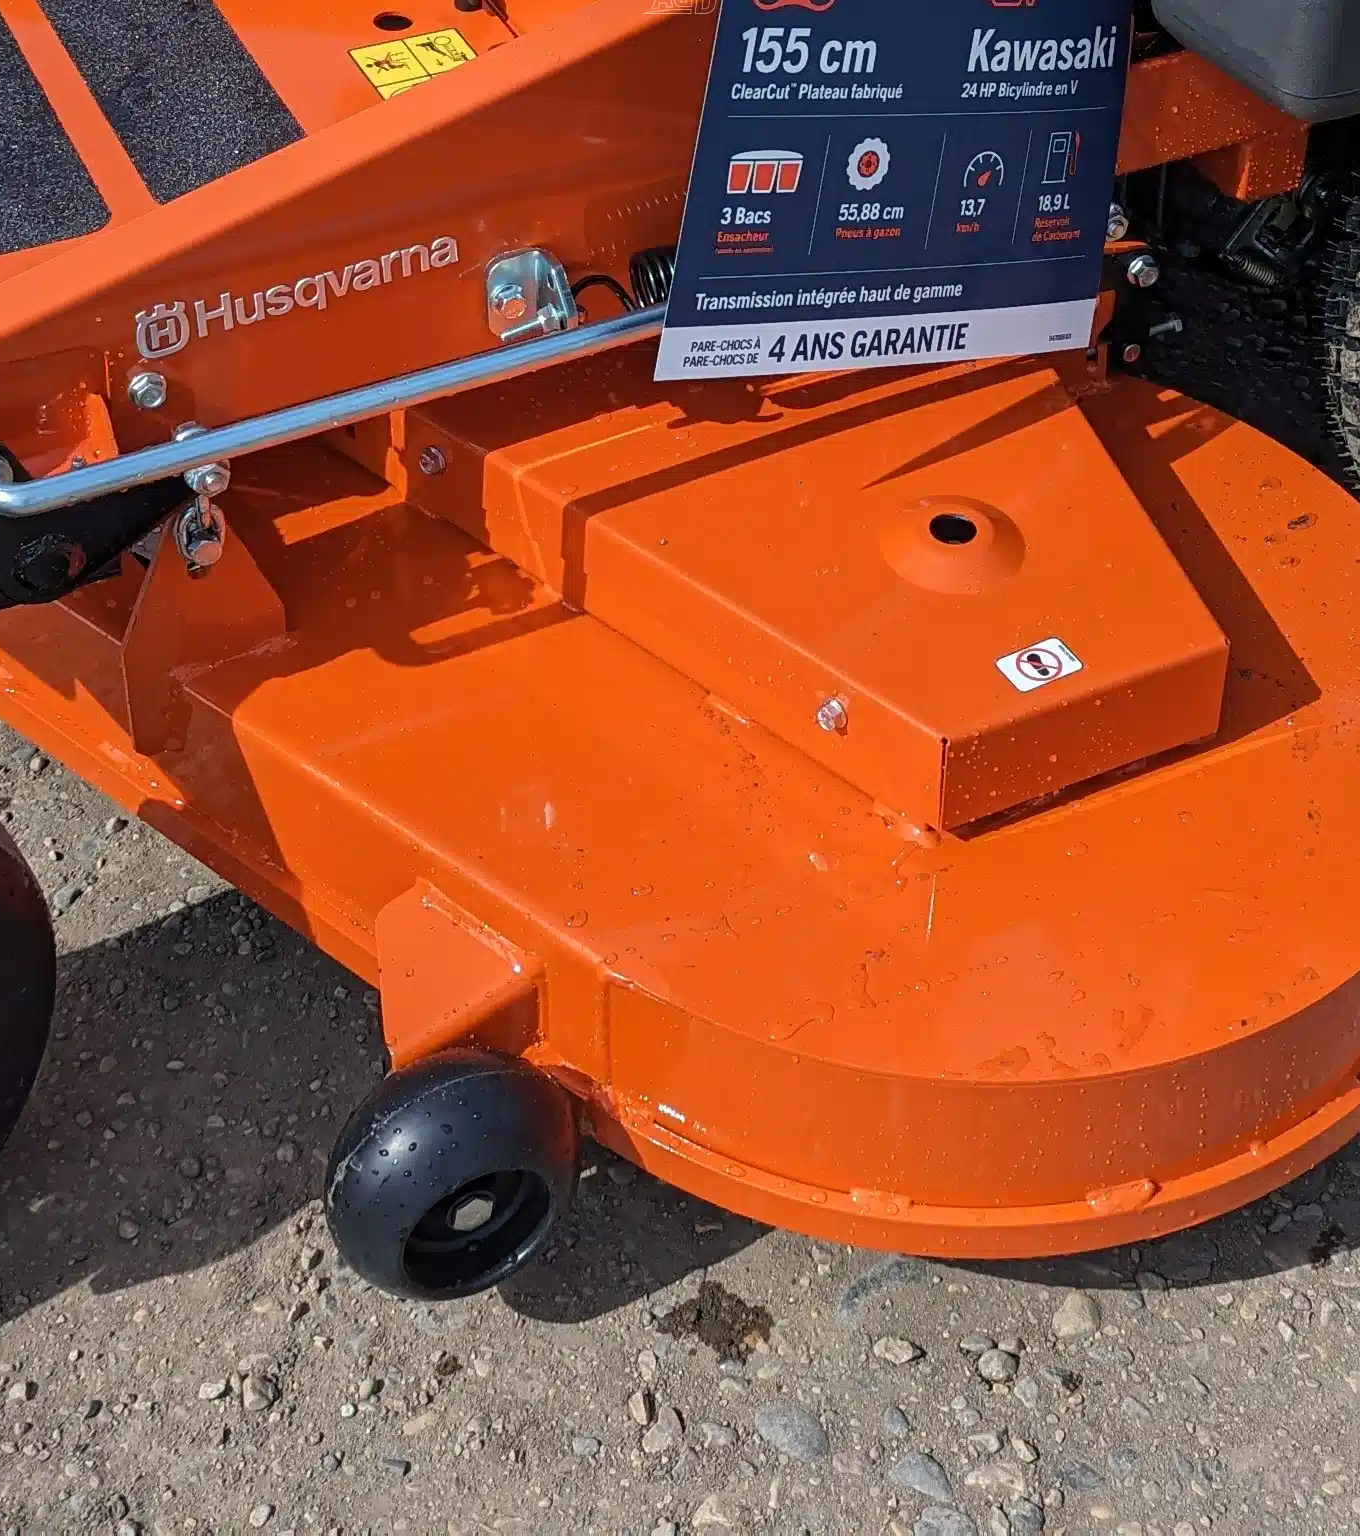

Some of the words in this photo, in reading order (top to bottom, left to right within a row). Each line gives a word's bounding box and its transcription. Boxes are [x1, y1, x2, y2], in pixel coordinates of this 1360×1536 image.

[741, 27, 810, 74] 155
[820, 37, 877, 74] cm
[967, 26, 1117, 73] Kawasaki
[799, 84, 848, 100] Plateau
[850, 83, 903, 102] fabriqué
[961, 82, 978, 98] 24
[980, 82, 998, 98] HP
[998, 81, 1053, 98] Bicylindre
[1055, 83, 1068, 95] en
[1070, 80, 1079, 95] V
[960, 198, 986, 217] 13,7
[1038, 194, 1062, 212] 18,9
[1064, 193, 1070, 210] L
[720, 207, 731, 225] 3
[735, 207, 771, 224] Bacs
[838, 203, 880, 223] 55,88
[883, 204, 904, 220] cm
[717, 230, 769, 243] Ensacheur
[194, 234, 461, 339] Husqvarna
[695, 289, 792, 311] Transmission
[797, 287, 857, 311] intégrée
[859, 285, 890, 303] haut
[894, 284, 910, 301] de
[913, 284, 962, 304] gamme
[690, 338, 752, 353] PARE-CHOCS
[753, 335, 761, 350] À
[768, 334, 786, 363] 4
[791, 332, 845, 362] ANS
[851, 323, 969, 358] GARANTIE
[683, 352, 745, 368] PARE-CHOCS
[747, 352, 759, 365] DE
